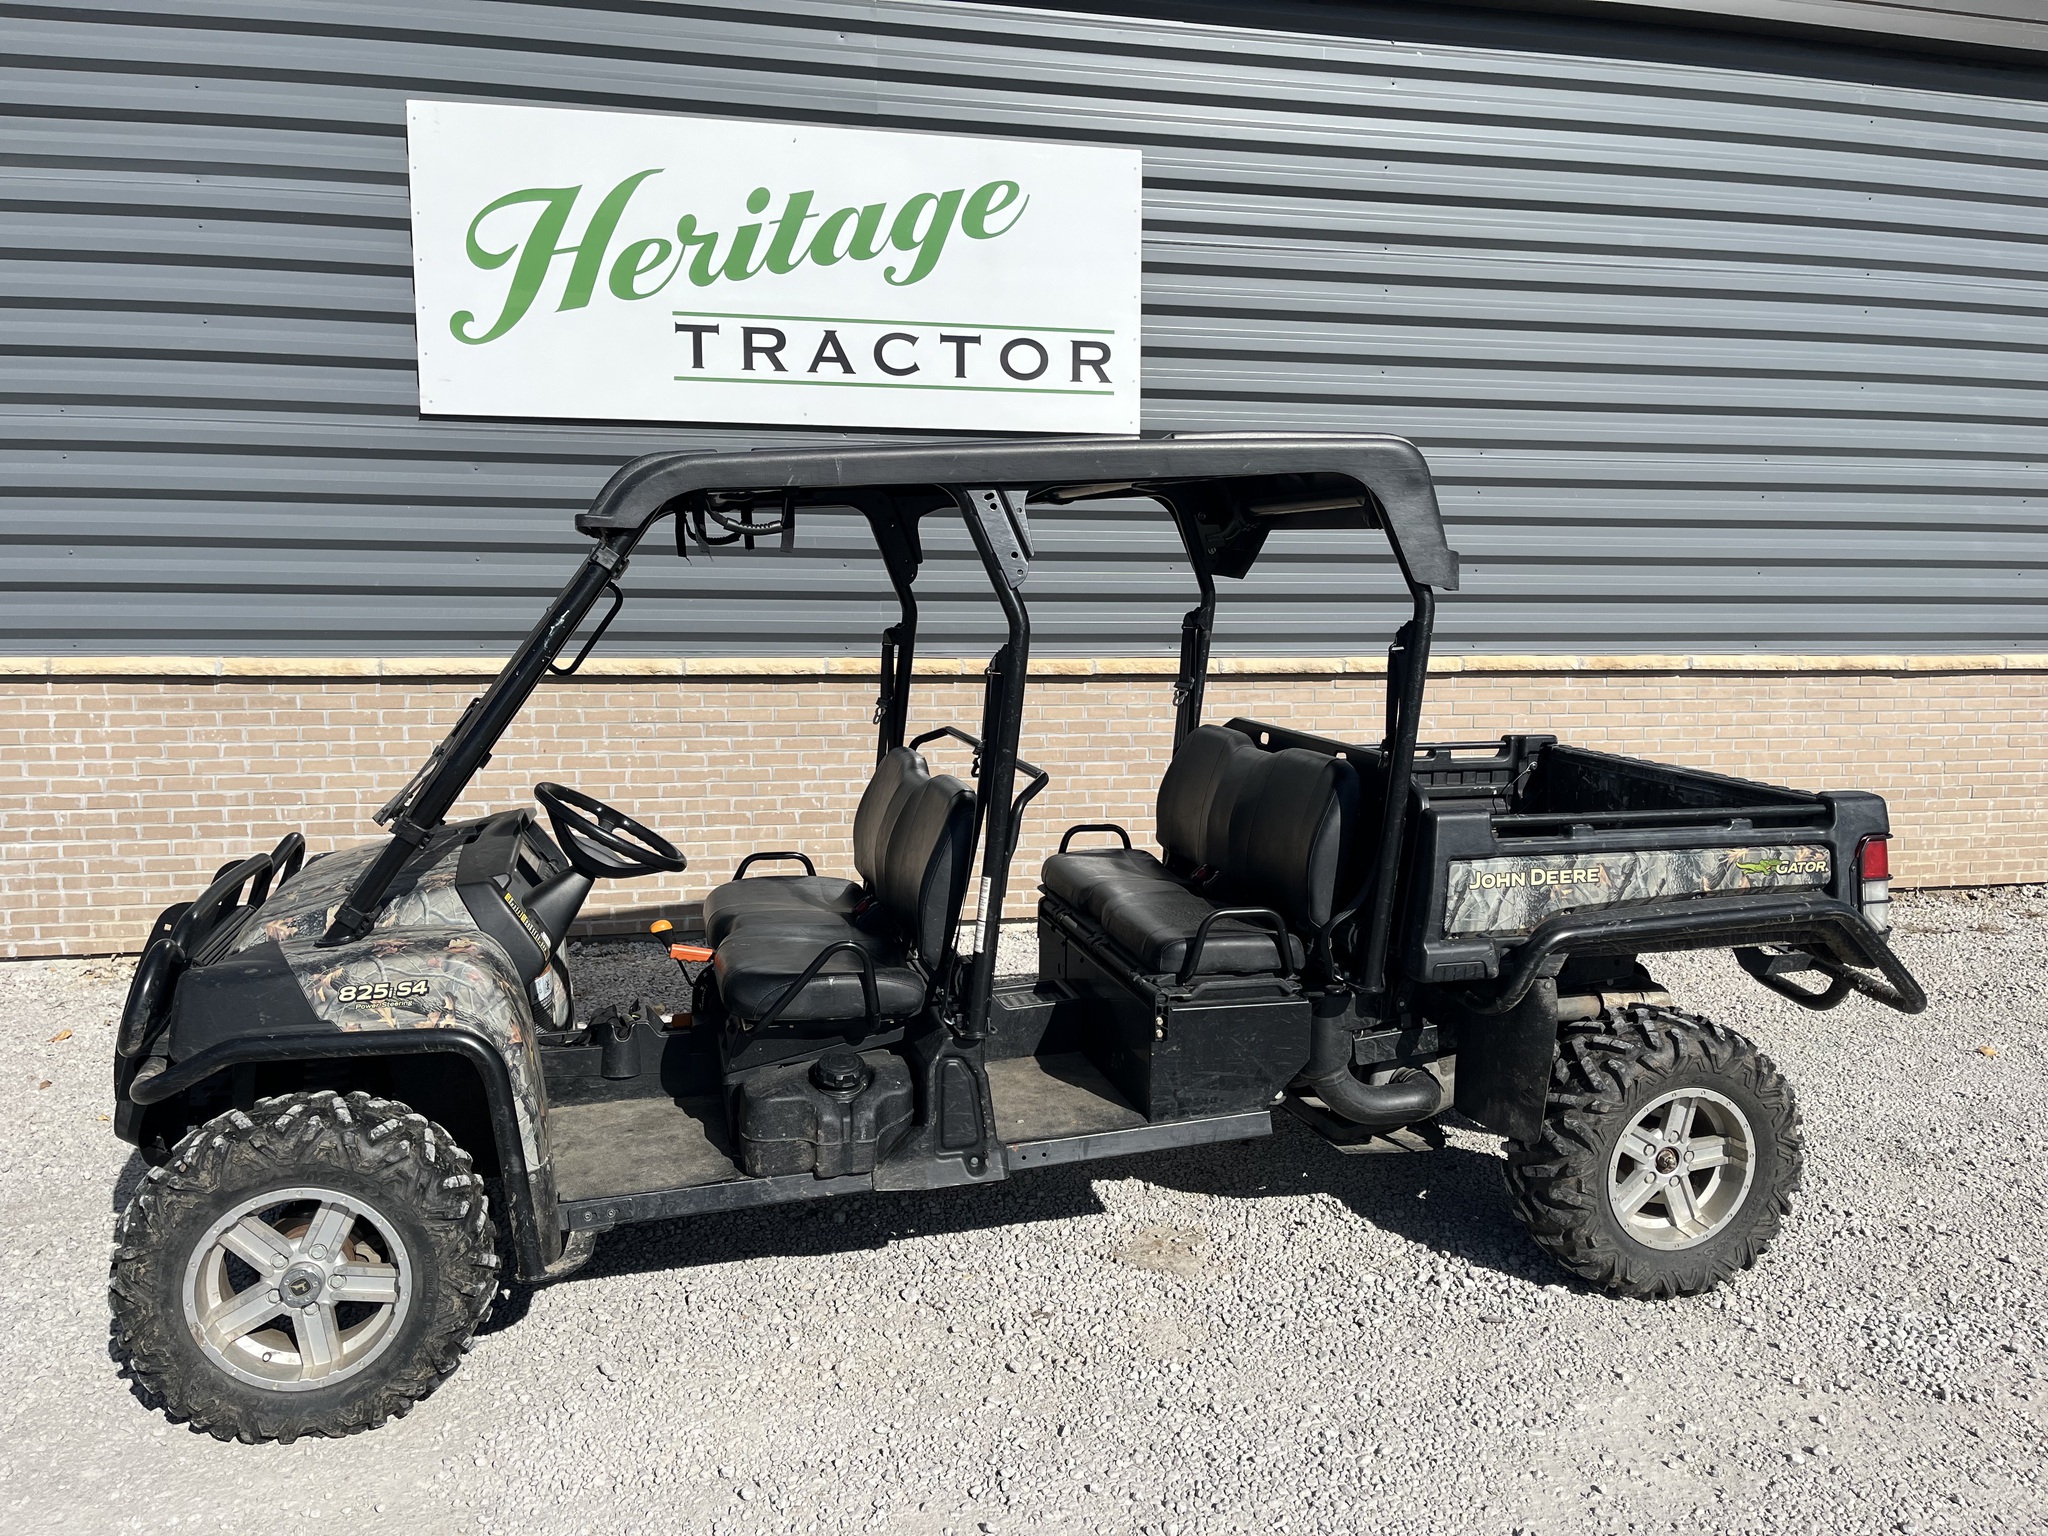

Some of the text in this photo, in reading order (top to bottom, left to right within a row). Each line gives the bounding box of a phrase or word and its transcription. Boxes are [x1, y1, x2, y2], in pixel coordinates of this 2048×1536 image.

[449, 168, 1030, 345] Heritage
[674, 321, 1112, 384] TRACTOR
[1776, 861, 1827, 875] GATOR
[1469, 868, 1599, 890] JOHN DEERE
[397, 980, 429, 997] S4
[355, 1000, 413, 1010] Power Steering
